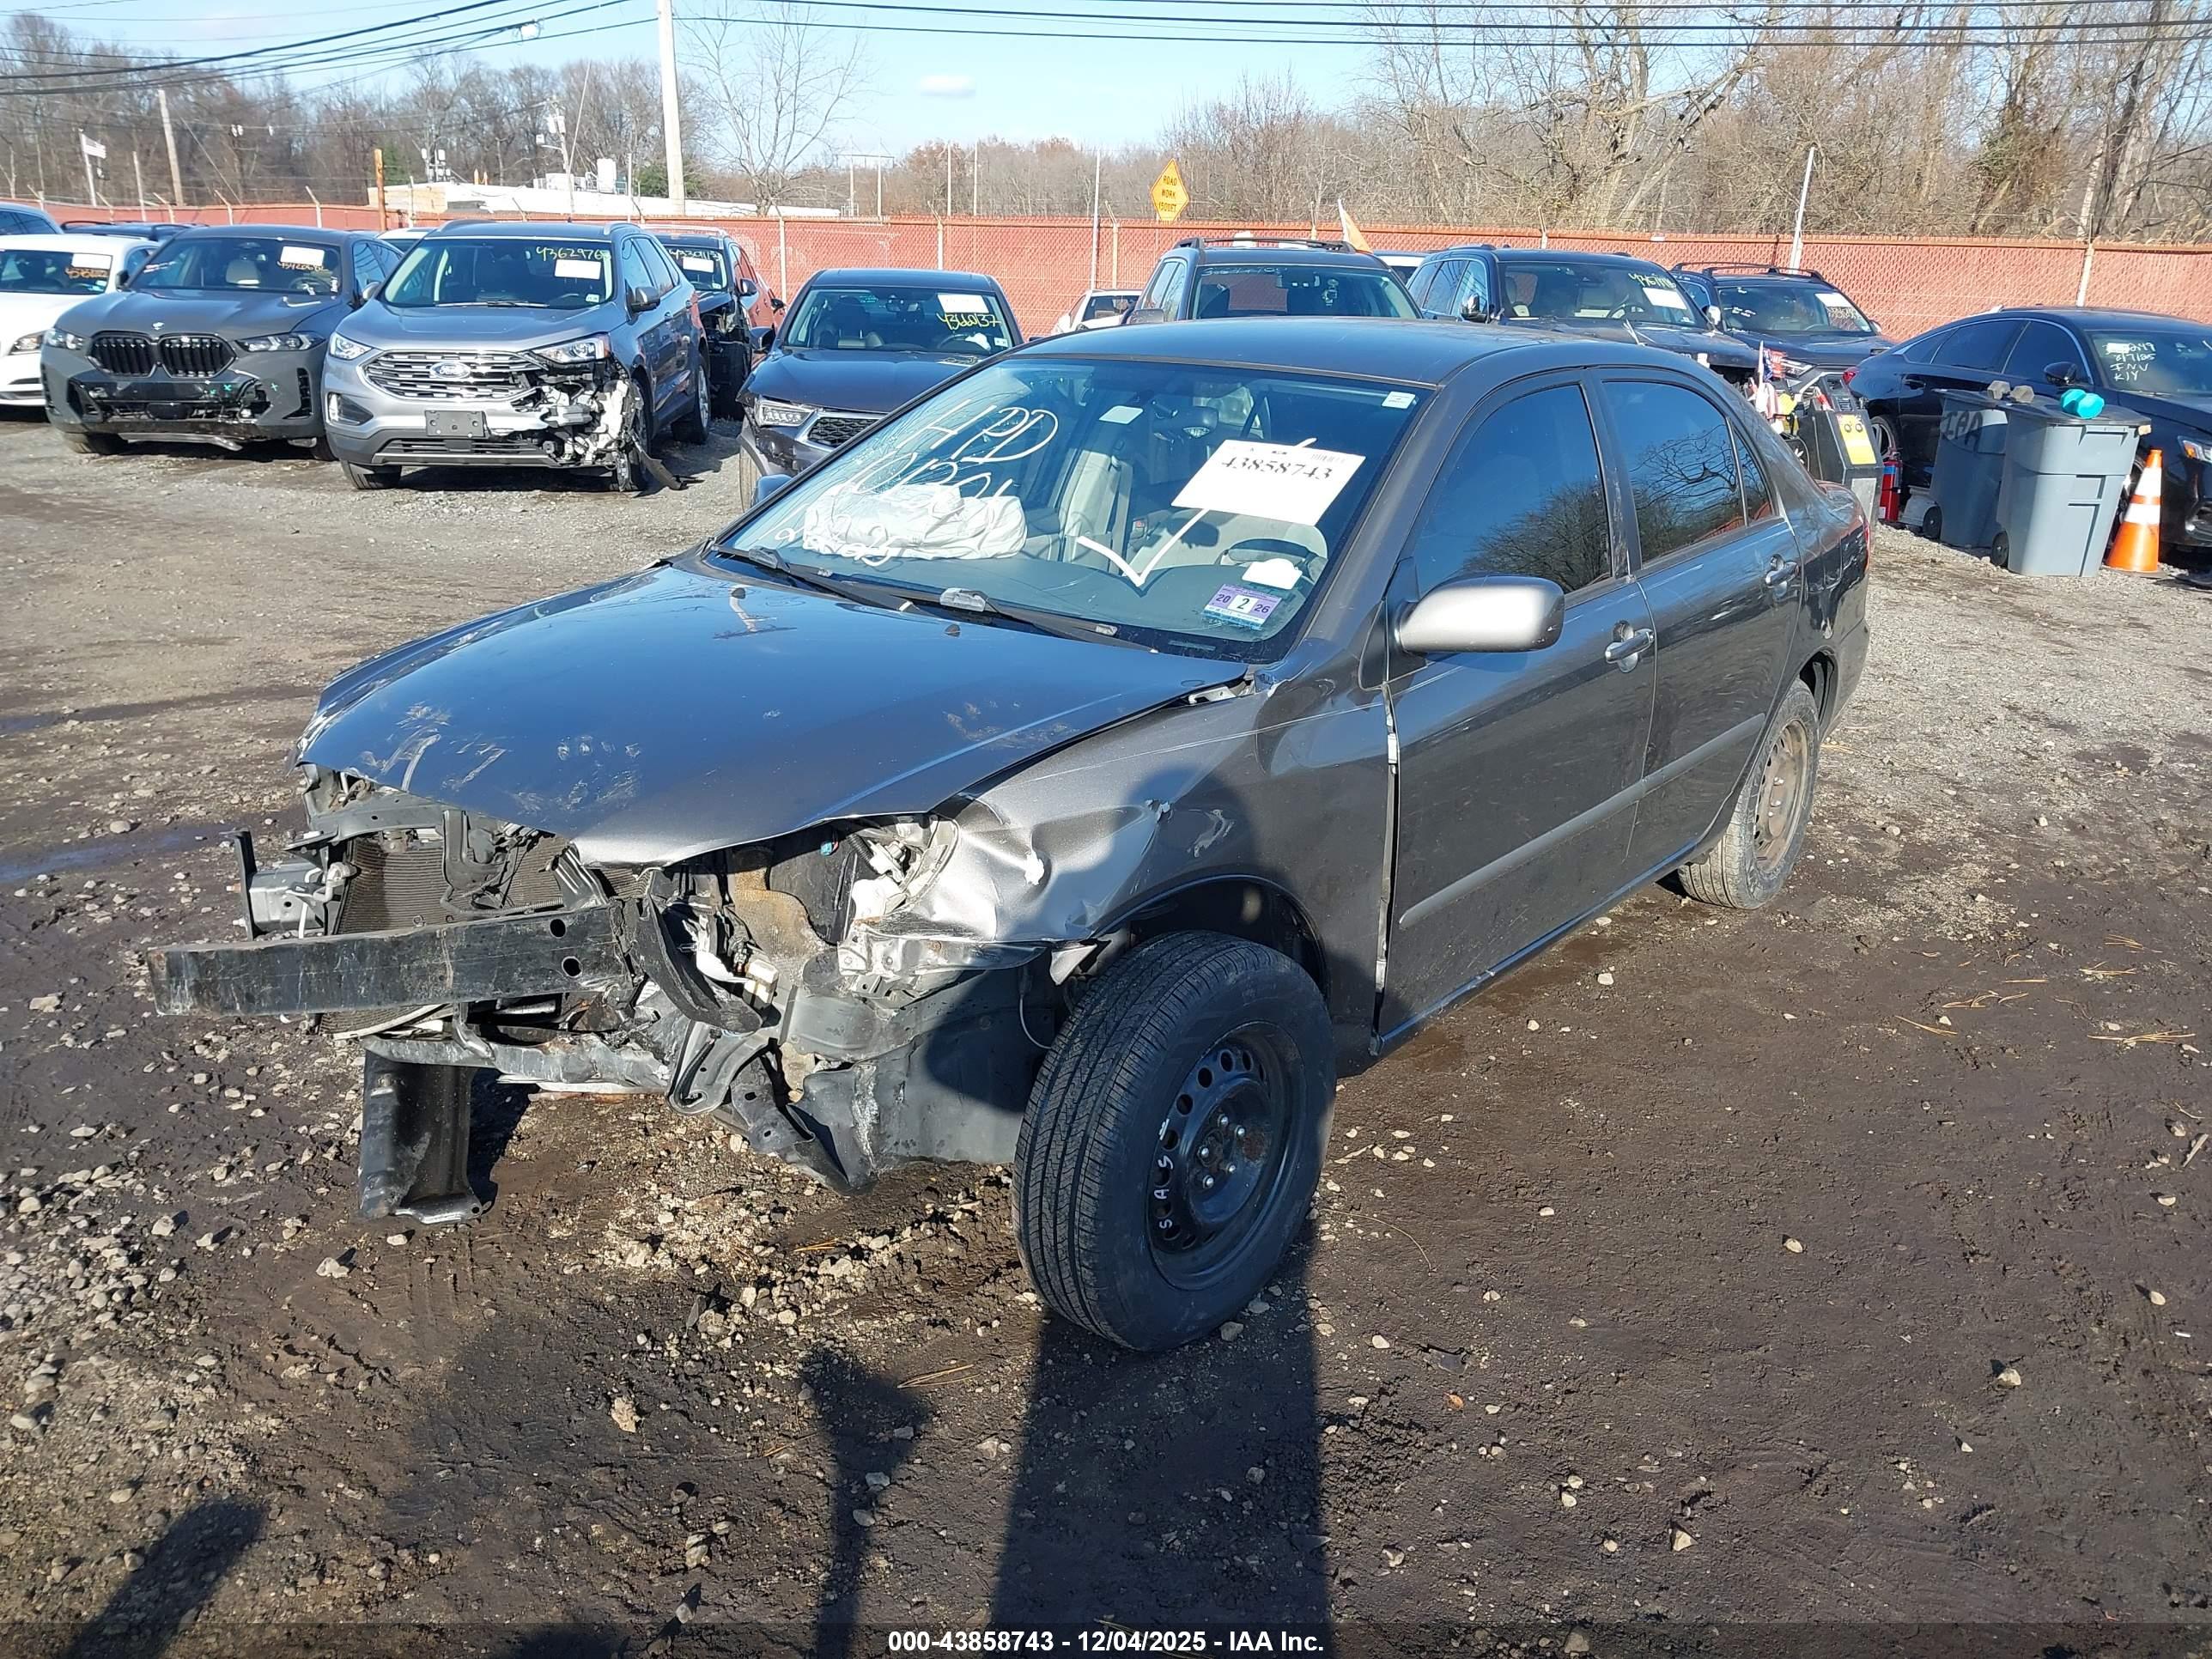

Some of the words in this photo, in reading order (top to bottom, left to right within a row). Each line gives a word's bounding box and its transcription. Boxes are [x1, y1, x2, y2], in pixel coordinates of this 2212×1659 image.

[1163, 175, 1177, 186] ROAD
[1161, 189, 1176, 199] WORK
[1942, 410, 1983, 453] IAA
[1221, 456, 1333, 480] 43858743
[1216, 593, 1232, 604] 20
[1237, 598, 1250, 610] 2
[1254, 604, 1271, 614] 26
